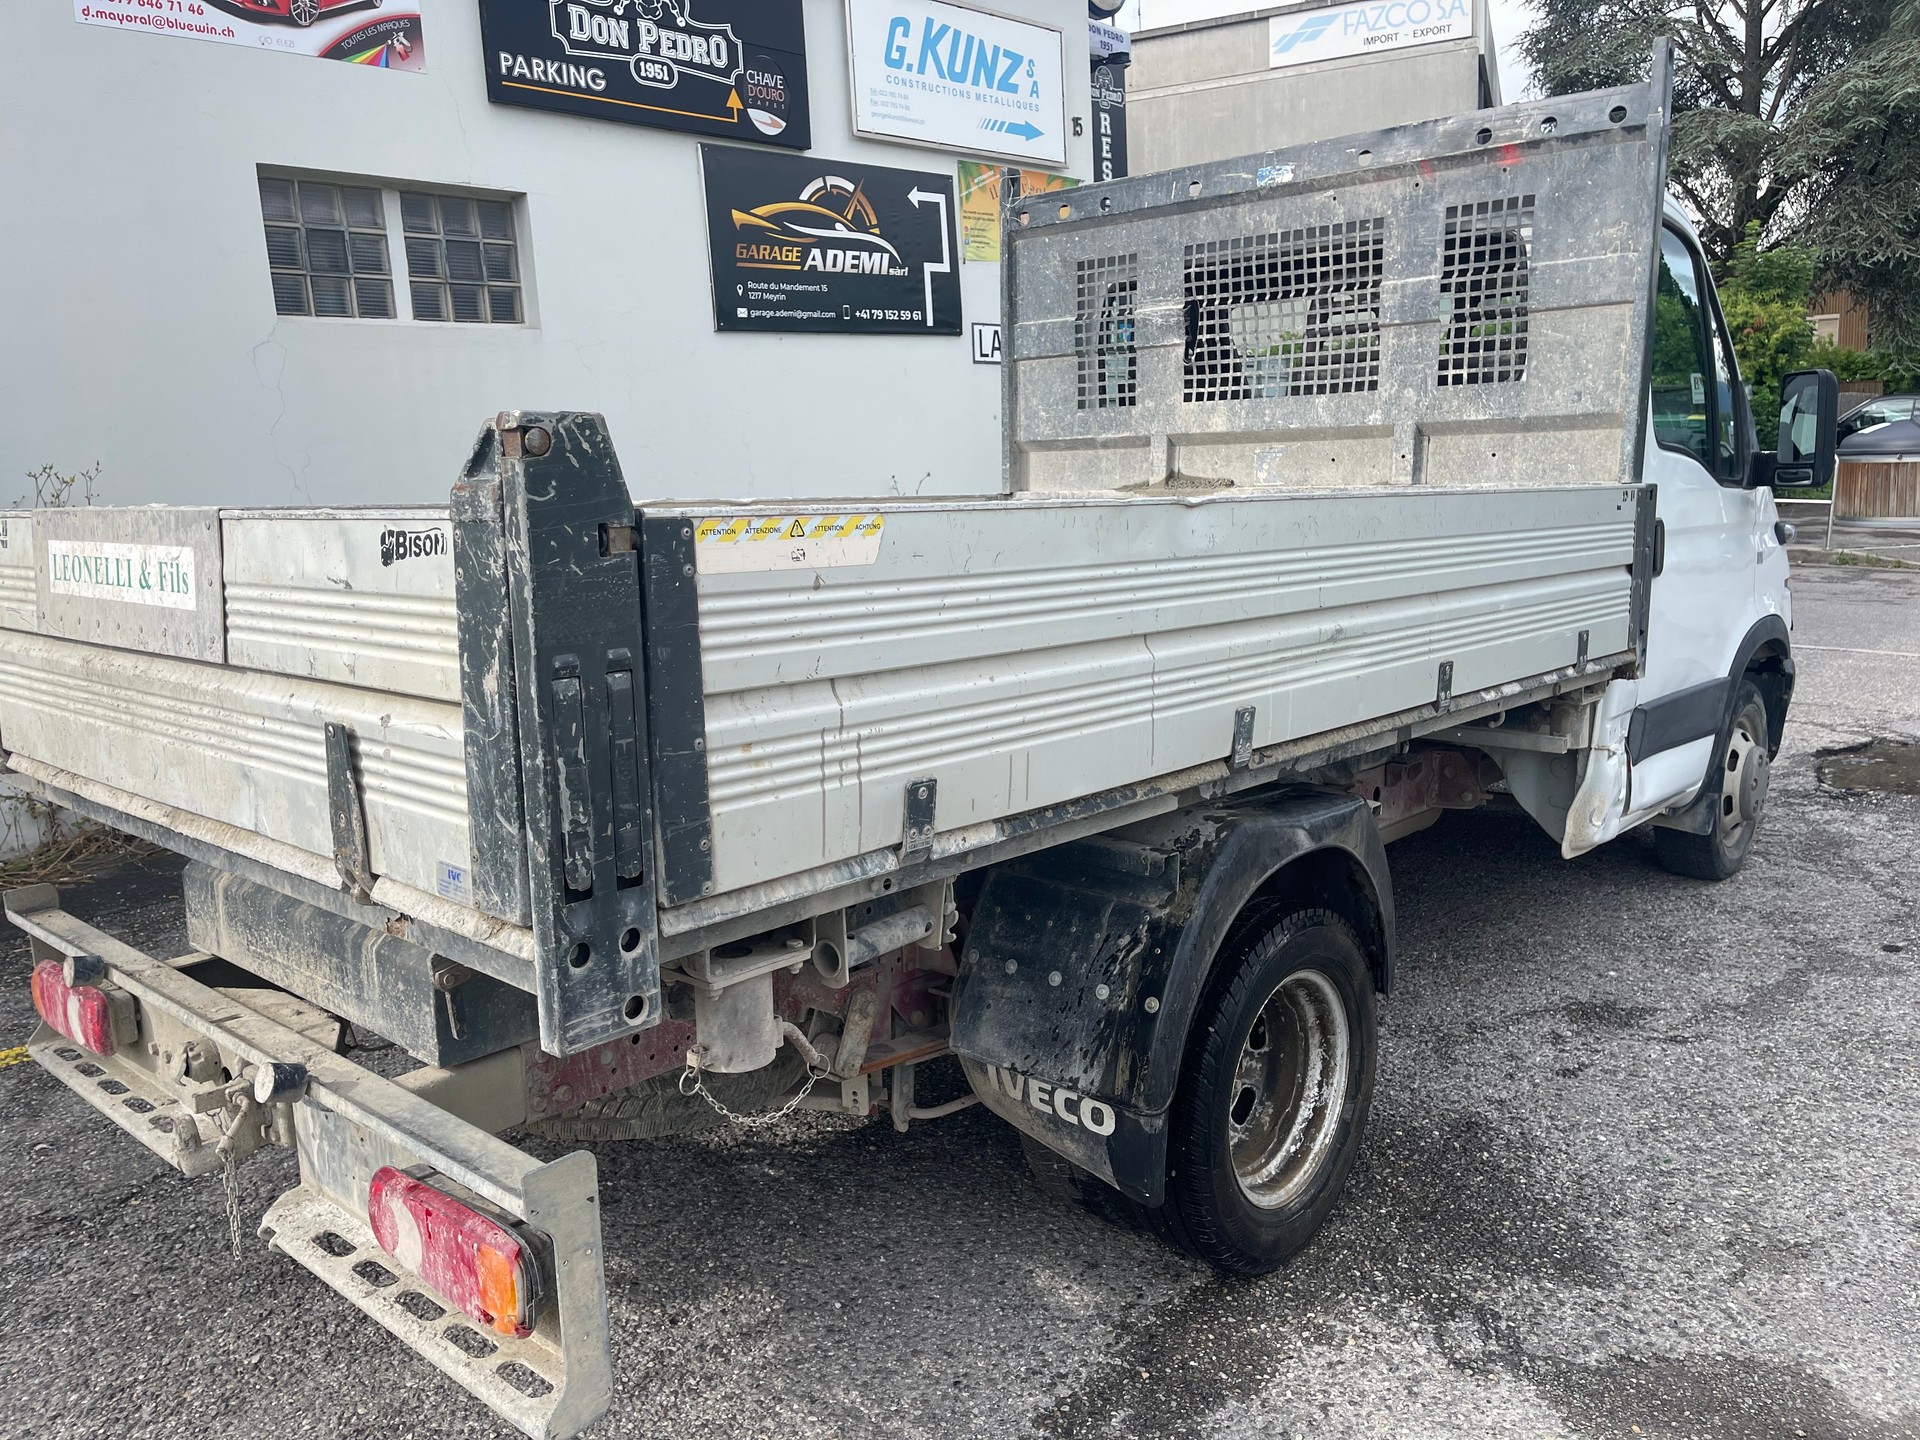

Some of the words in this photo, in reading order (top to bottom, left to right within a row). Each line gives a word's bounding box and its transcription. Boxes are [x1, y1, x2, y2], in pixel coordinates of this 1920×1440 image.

[167, 0, 183, 13] 71
[188, 3, 204, 16] 46
[1343, 0, 1431, 36] FAZCO
[1436, 0, 1469, 20] S.A.
[81, 5, 235, 38] d.mayoral@bluewin.ch
[276, 38, 295, 48] ELEZI
[340, 31, 366, 51] TOUTES
[365, 25, 378, 37] LES
[377, 18, 411, 33] MARQUES
[567, 3, 629, 51] DON
[637, 18, 728, 69] PEDRO
[1103, 28, 1124, 43] PEDRO
[1363, 32, 1400, 46] IMPORT
[1413, 24, 1452, 38] EXPORT
[884, 16, 1024, 95] G.KUNZ
[1100, 40, 1113, 52] 1951
[498, 51, 607, 91] PARKING
[639, 61, 669, 81] 1951
[746, 70, 784, 89] CHAVE
[748, 84, 785, 102] D'OURO
[886, 74, 971, 99] CONSTRUCTIONS
[975, 92, 1040, 112] METALLIQUES
[1072, 116, 1083, 136] 15
[736, 243, 802, 262] GARAGE
[803, 248, 890, 275] ADEMI
[747, 281, 768, 290] Route
[769, 282, 779, 290] du
[780, 283, 820, 292] Mandement
[821, 284, 828, 292] 15
[748, 291, 762, 300] 1217
[763, 292, 786, 302] Meyrin
[750, 309, 836, 319] garage.ademi@gmail.com
[855, 309, 870, 319] +41
[871, 309, 884, 320] 79
[884, 309, 899, 320] 152
[900, 310, 911, 320] 59
[912, 310, 922, 321] 61
[700, 528, 736, 536] ATTENTION
[744, 526, 783, 535] ATTENZIONE
[855, 523, 881, 531] ACHTUNG
[53, 553, 132, 588] LEONELLI
[139, 559, 152, 590] &
[158, 561, 189, 595] Fils
[987, 1063, 1116, 1136] IVECO
